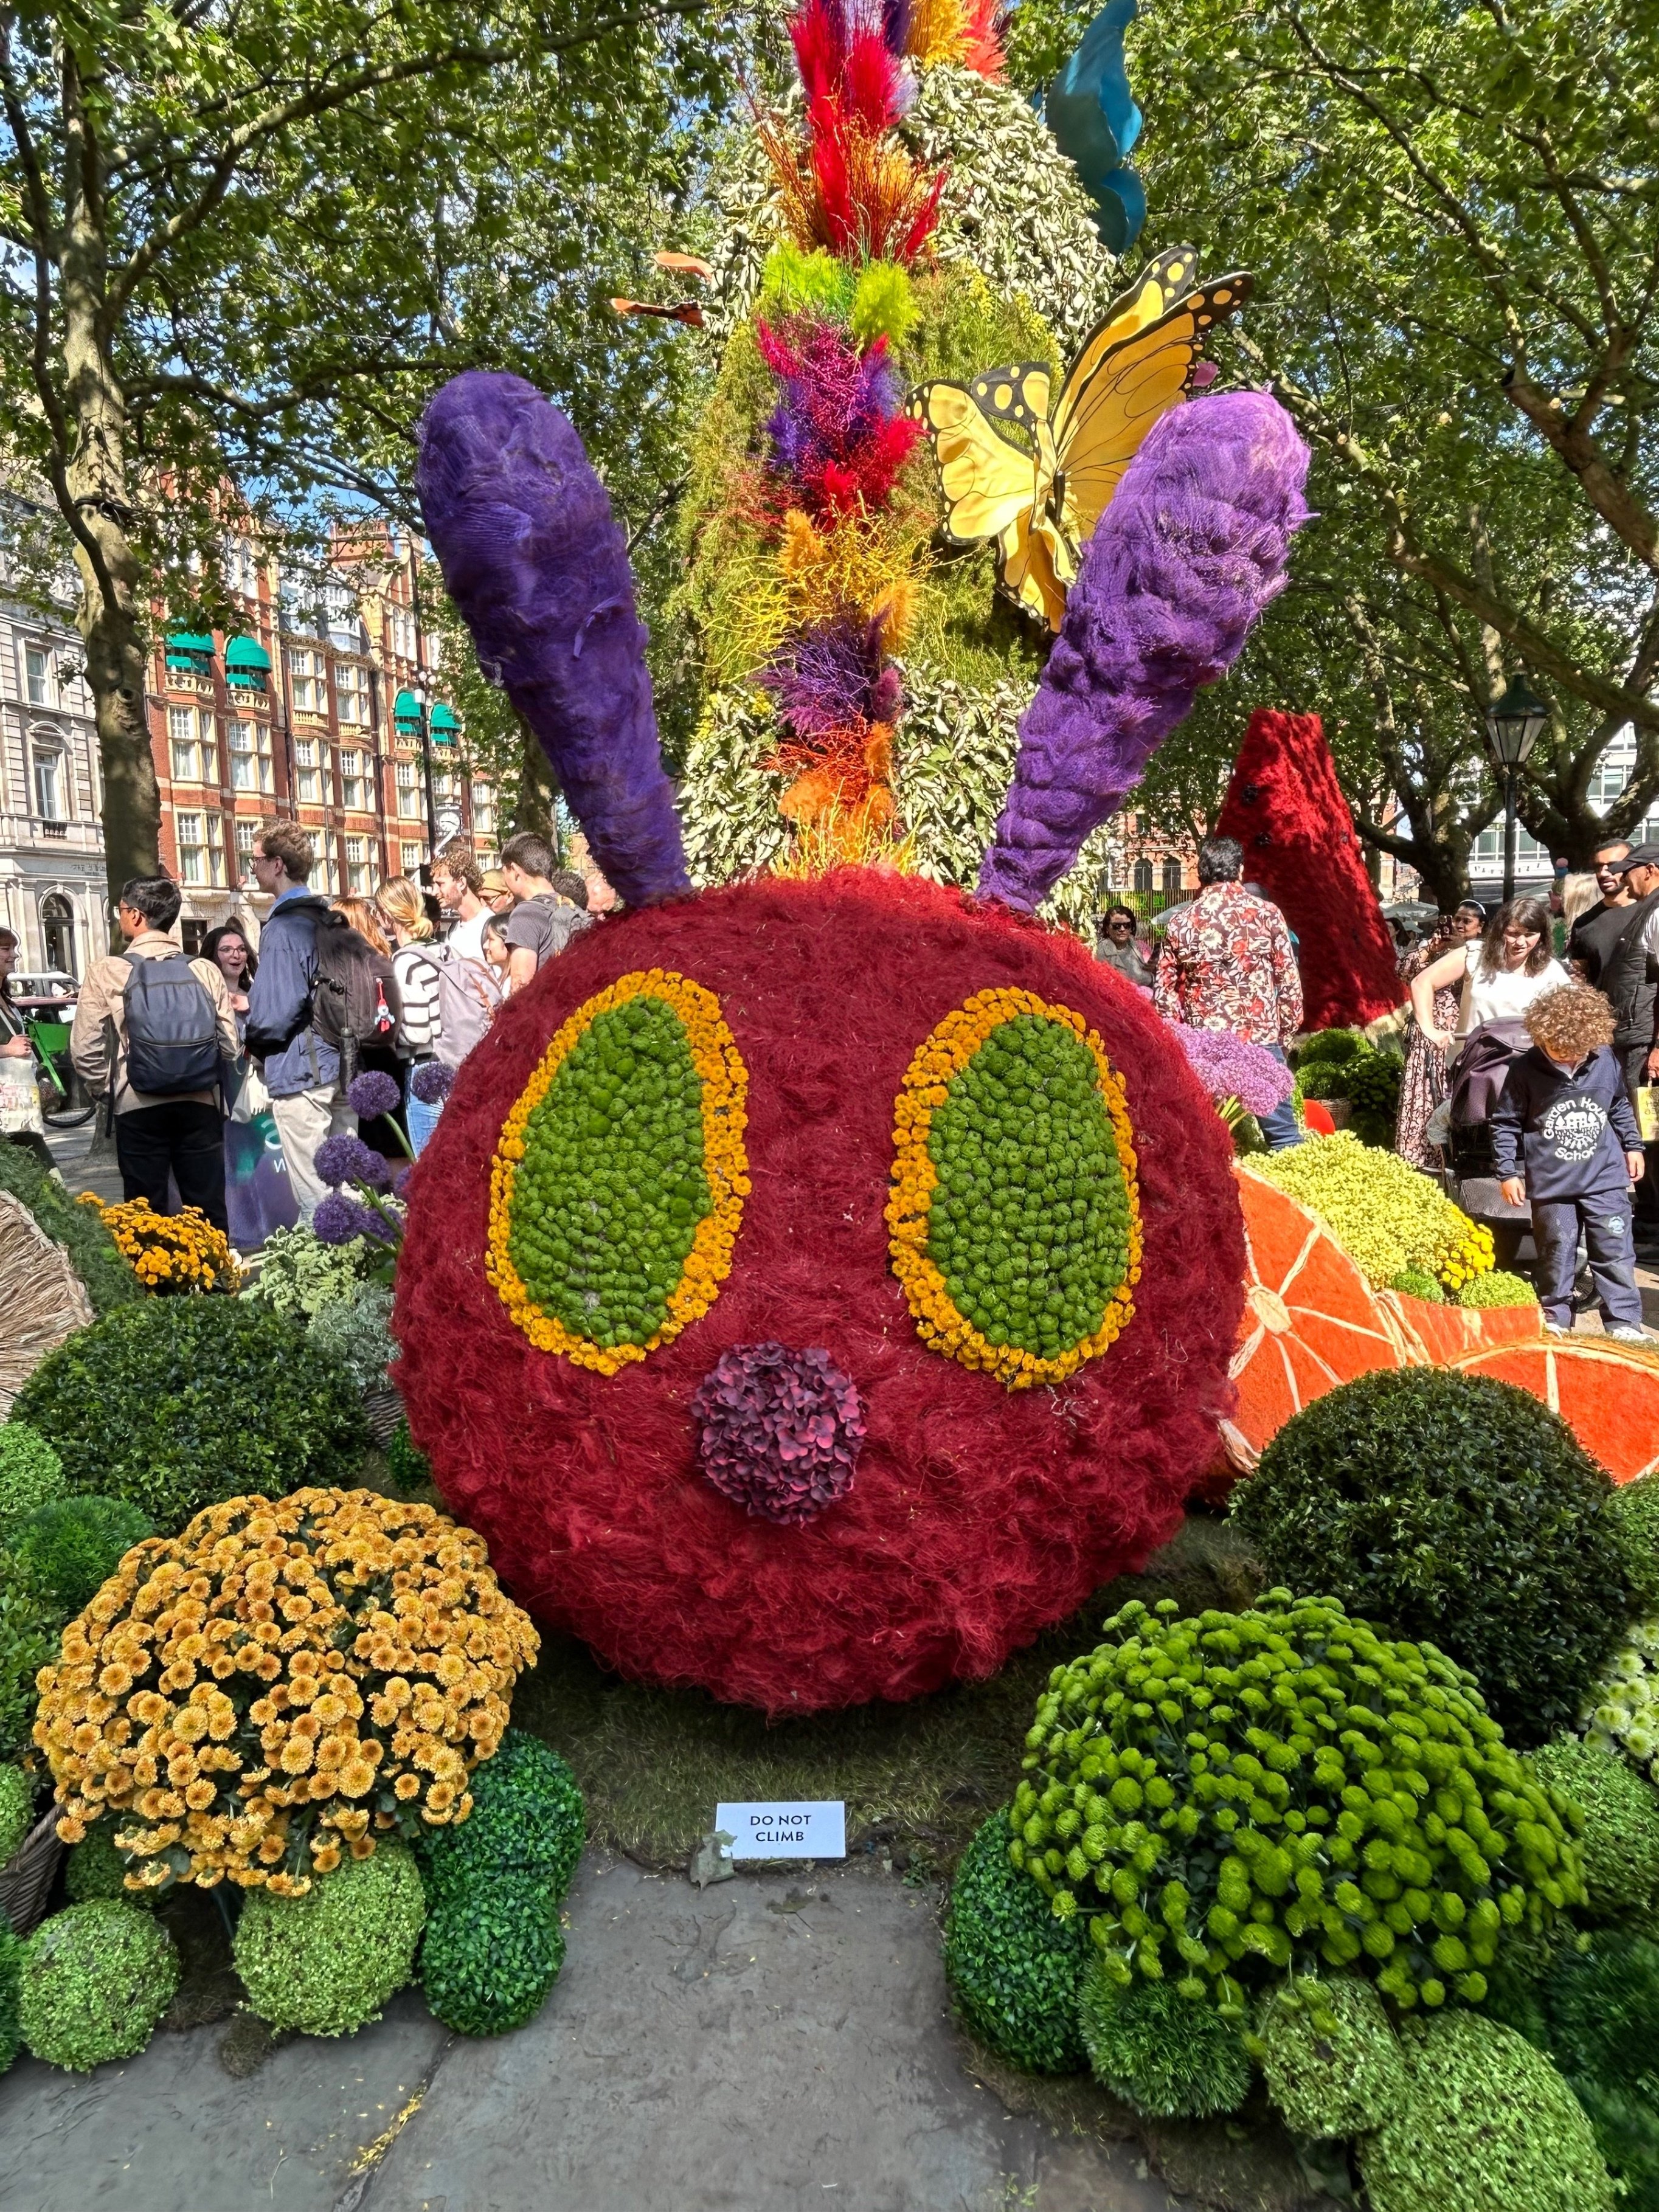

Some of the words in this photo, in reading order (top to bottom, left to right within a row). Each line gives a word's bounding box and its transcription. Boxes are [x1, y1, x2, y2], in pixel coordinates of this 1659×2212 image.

[1543, 1099, 1576, 1139] Garden
[1554, 1142, 1598, 1161] Schoo
[750, 1816, 774, 1825] DO
[779, 1815, 811, 1825] NOT
[756, 1831, 804, 1842] CLIMB
